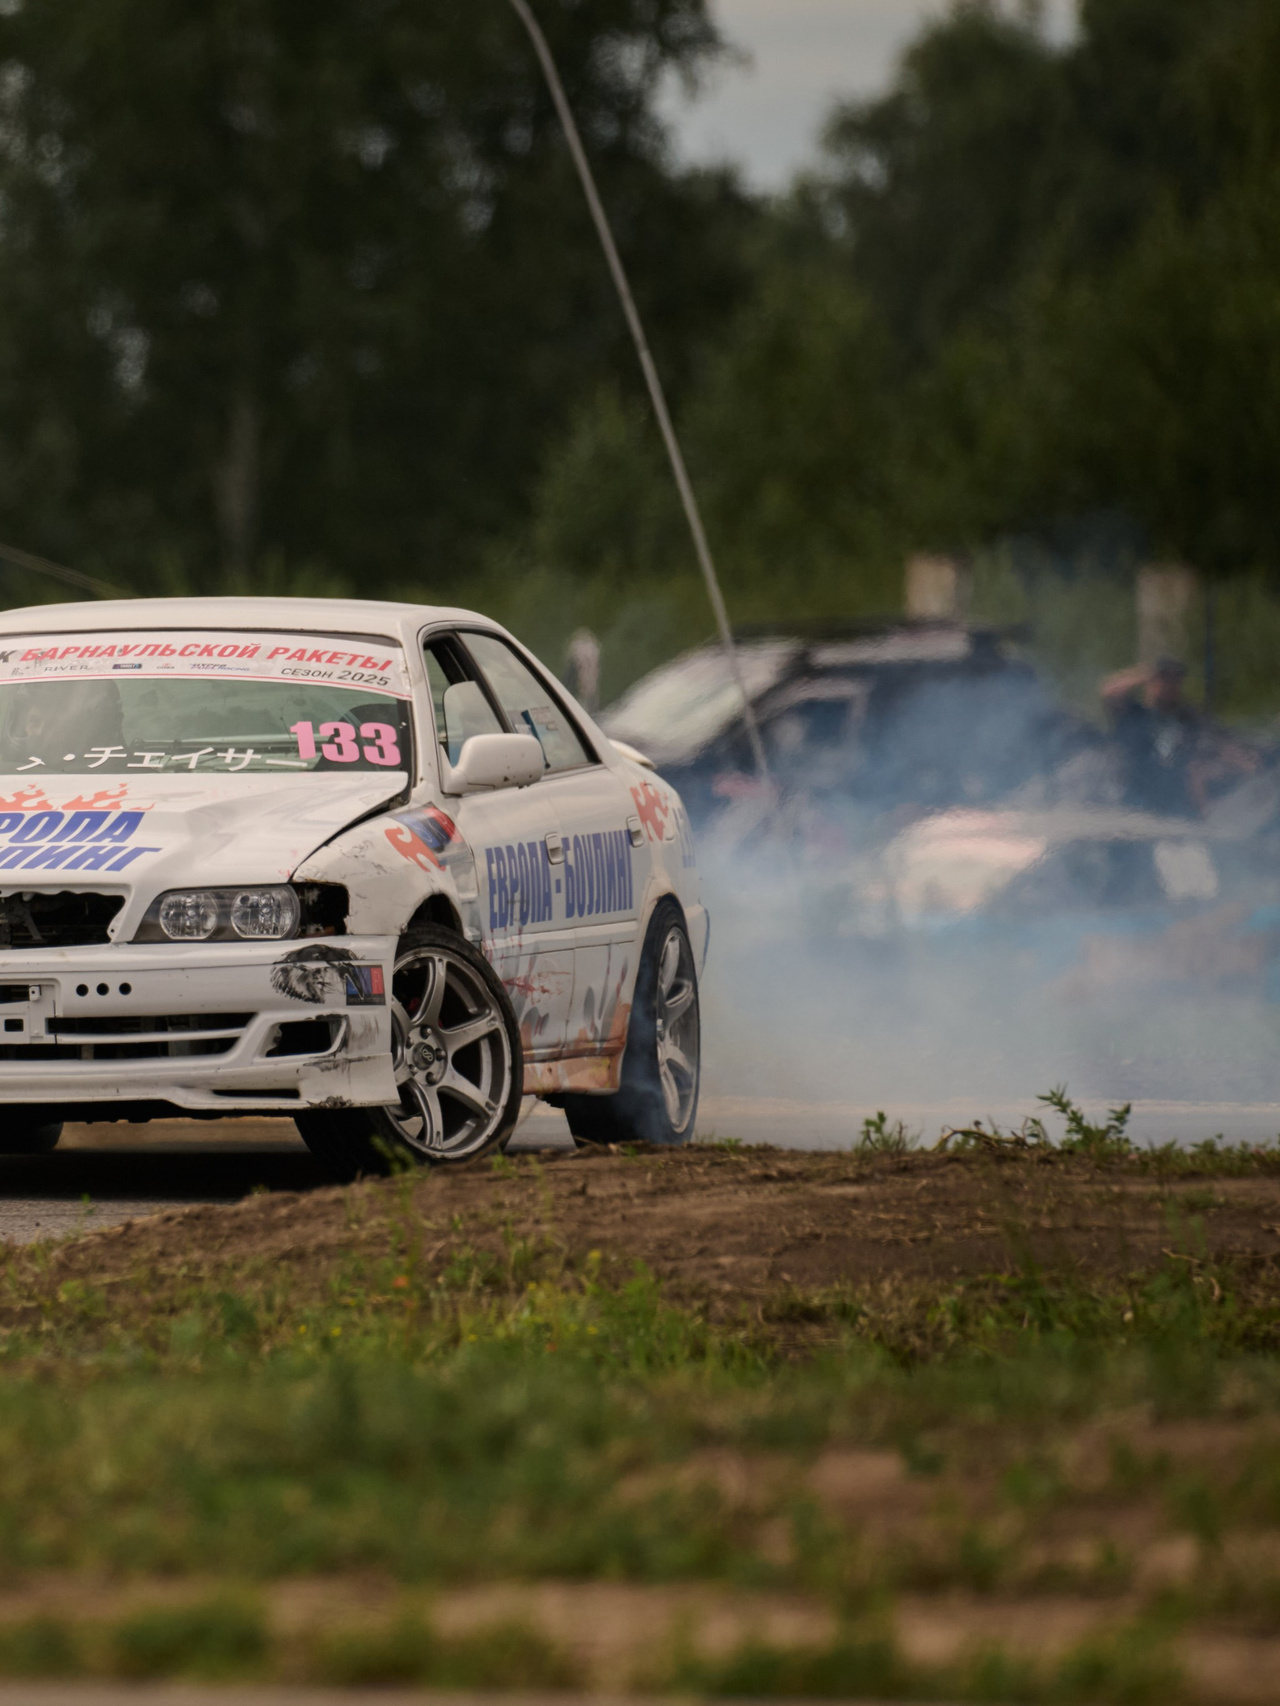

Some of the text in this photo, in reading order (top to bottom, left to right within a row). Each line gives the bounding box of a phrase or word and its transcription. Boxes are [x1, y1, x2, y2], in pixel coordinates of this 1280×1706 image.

[19, 642, 262, 662] БАРНАУЛЬСКОЙ
[267, 646, 394, 672] РАКЕТЫ
[281, 667, 392, 687] СЕЗОН 2025
[289, 721, 402, 766] 133
[485, 840, 553, 930] ЕВРОПА
[561, 829, 634, 919] БОУЛИНГ
